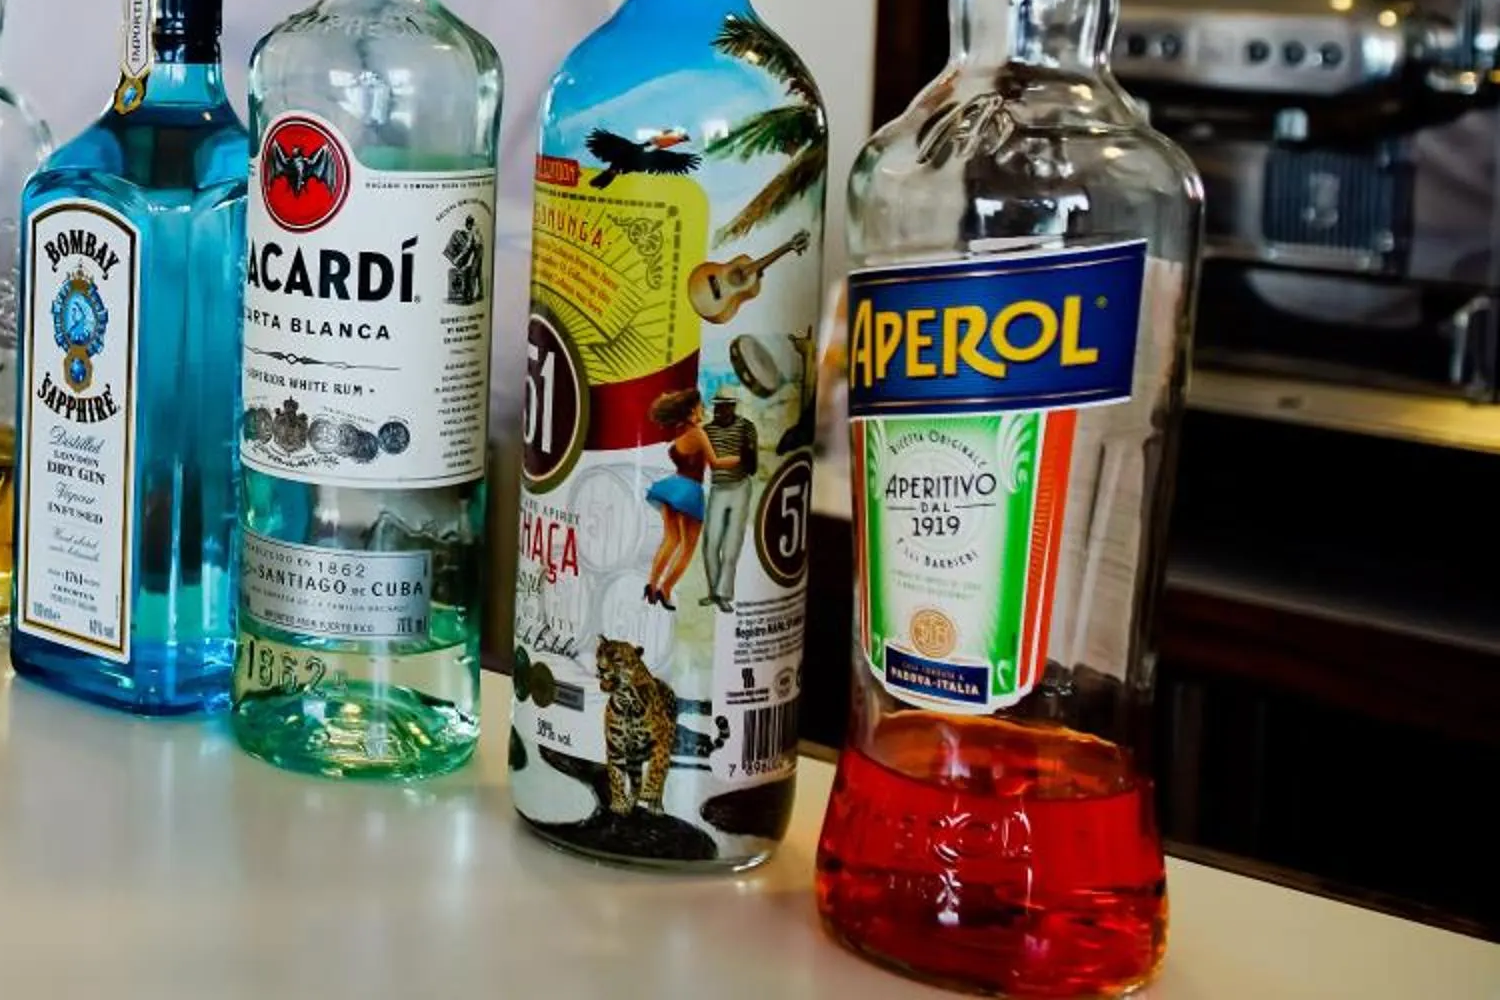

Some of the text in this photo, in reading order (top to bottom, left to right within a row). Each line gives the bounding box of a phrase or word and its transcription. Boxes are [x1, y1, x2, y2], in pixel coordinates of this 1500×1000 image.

[43, 229, 120, 281] BOMBAY
[247, 235, 419, 303] ACARDÍ
[290, 316, 390, 340] BLANCA
[850, 295, 1099, 388] APEROL
[37, 371, 118, 424] SAPPHIRE
[288, 377, 328, 393] WHITE
[333, 383, 363, 396] RUM
[522, 344, 556, 455] 51
[52, 449, 100, 468] LONDON
[47, 461, 106, 486] DRY GIN
[885, 473, 997, 499] APERITIVO
[47, 501, 103, 526] INFUSED
[920, 503, 951, 513] DAL
[911, 516, 960, 537] 1919
[520, 511, 579, 584] HAÇA
[257, 564, 347, 595] SANTIAGO
[371, 580, 423, 597] CUBA
[317, 558, 366, 579] 1862
